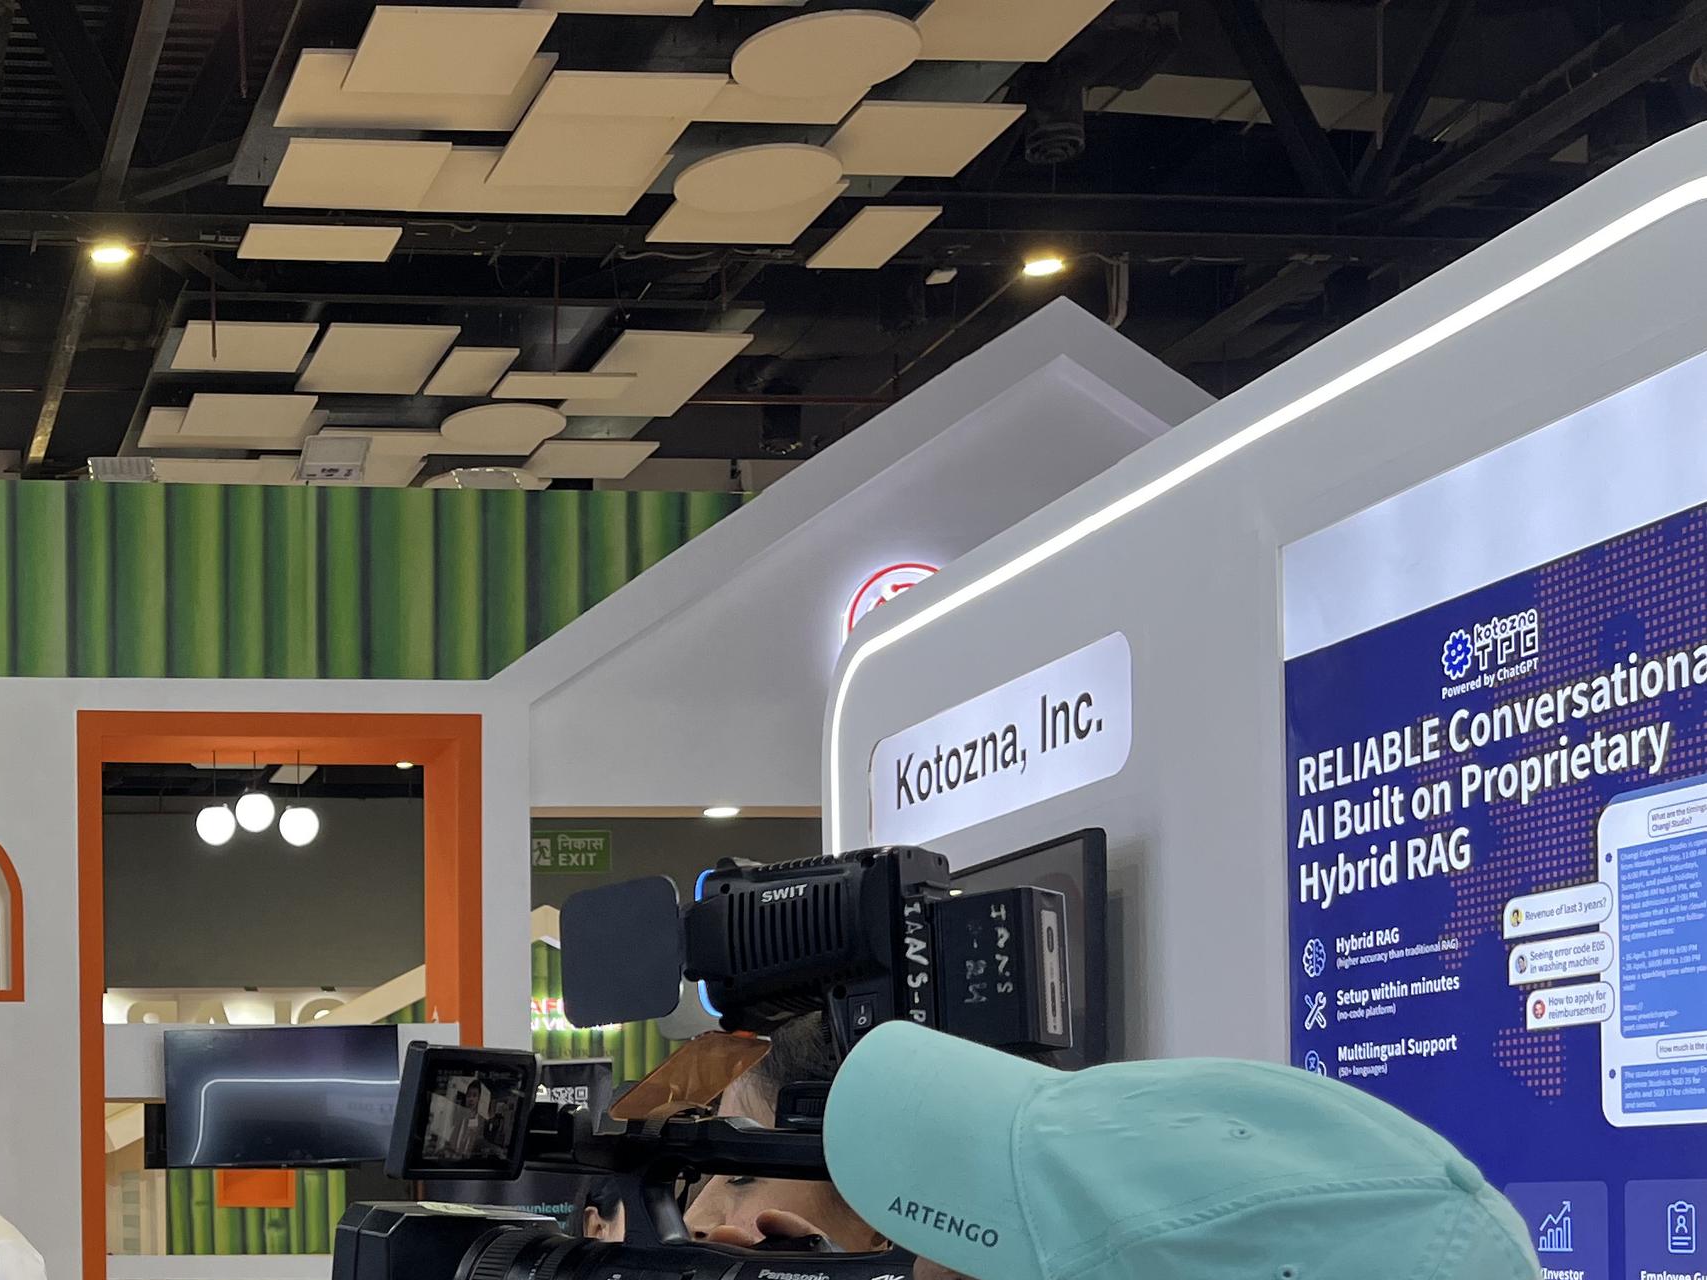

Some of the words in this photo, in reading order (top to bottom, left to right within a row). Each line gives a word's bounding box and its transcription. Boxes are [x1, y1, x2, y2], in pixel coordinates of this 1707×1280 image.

[1473, 608, 1538, 642] kotozna
[1441, 678, 1482, 700] Powered
[1482, 675, 1496, 690] by
[1496, 657, 1539, 682] ChatGPT
[1298, 716, 1441, 797] RELIABLE
[1448, 643, 1707, 753] Conversationa
[895, 723, 1027, 811] Kotozna,
[1040, 691, 1103, 754] Inc.
[1297, 807, 1325, 849] AI
[1333, 783, 1404, 841] Built
[1411, 779, 1452, 822] on
[1460, 720, 1671, 809] Proprietary
[1651, 812, 1666, 821] What
[1676, 808, 1686, 817] the
[1671, 817, 1693, 828] Studio?
[557, 833, 605, 851] निकास
[558, 853, 597, 867] EXIT
[1298, 841, 1398, 910] Hybrid
[1406, 826, 1472, 881] RAG
[761, 883, 808, 903] SWIT
[1525, 908, 1554, 921] Revenue
[1555, 906, 1564, 916] of
[1563, 902, 1577, 913] last
[1578, 902, 1583, 912] 3
[1583, 897, 1607, 912] years?
[1336, 930, 1374, 956] Hybrid
[1376, 927, 1400, 947] RAG
[1359, 951, 1388, 964] accuracy
[1389, 948, 1405, 960] than
[1404, 941, 1441, 957] traditional
[1441, 937, 1459, 951] RAG)
[1530, 948, 1554, 961] Seeing
[1554, 946, 1572, 957] error
[1573, 943, 1591, 953] code
[1530, 964, 1537, 974] in
[1538, 959, 1567, 972] washing
[1568, 955, 1599, 968] machine
[1336, 988, 1369, 1007] Setup
[1370, 980, 1408, 1001] within
[1410, 975, 1460, 996] minutes
[1548, 996, 1564, 1007] How
[1565, 993, 1573, 1003] to
[1574, 991, 1594, 1005] apply
[1595, 990, 1607, 1000] for
[1336, 1007, 1365, 1022] (no-code
[1365, 1002, 1397, 1019] platform)
[1548, 1003, 1607, 1020] reimbursement?
[1337, 1038, 1406, 1062] Multilingual
[1407, 1033, 1458, 1057] Support
[1659, 1044, 1672, 1054] How
[1673, 1042, 1689, 1052] much
[1694, 1040, 1705, 1049] the
[1352, 1063, 1388, 1077] languages)
[517, 1202, 575, 1214] unicatio
[887, 1196, 999, 1248] ARTENGO
